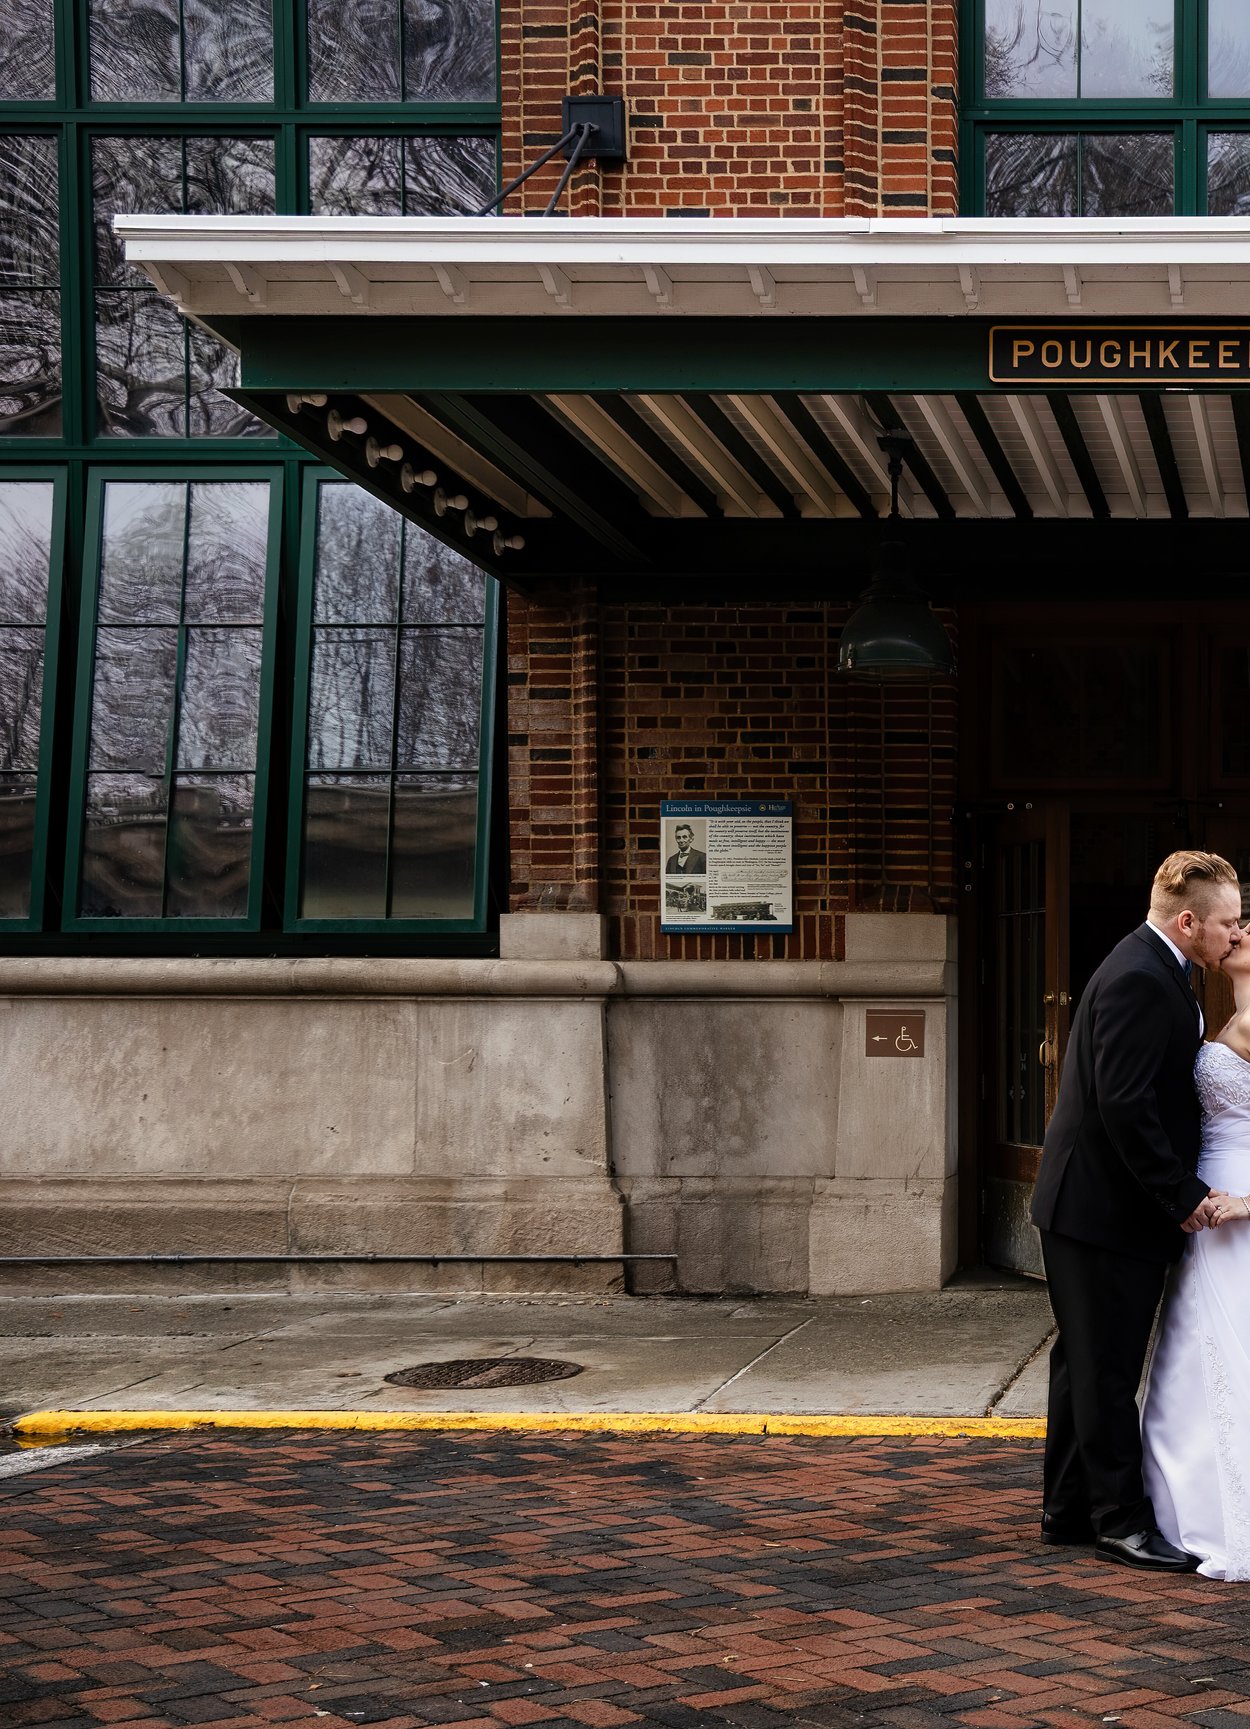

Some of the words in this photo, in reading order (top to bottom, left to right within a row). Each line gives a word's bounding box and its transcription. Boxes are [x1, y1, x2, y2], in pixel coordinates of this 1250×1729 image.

[666, 804, 693, 812] Lincoln
[694, 804, 702, 812] in
[703, 804, 752, 815] Poughkeepsie
